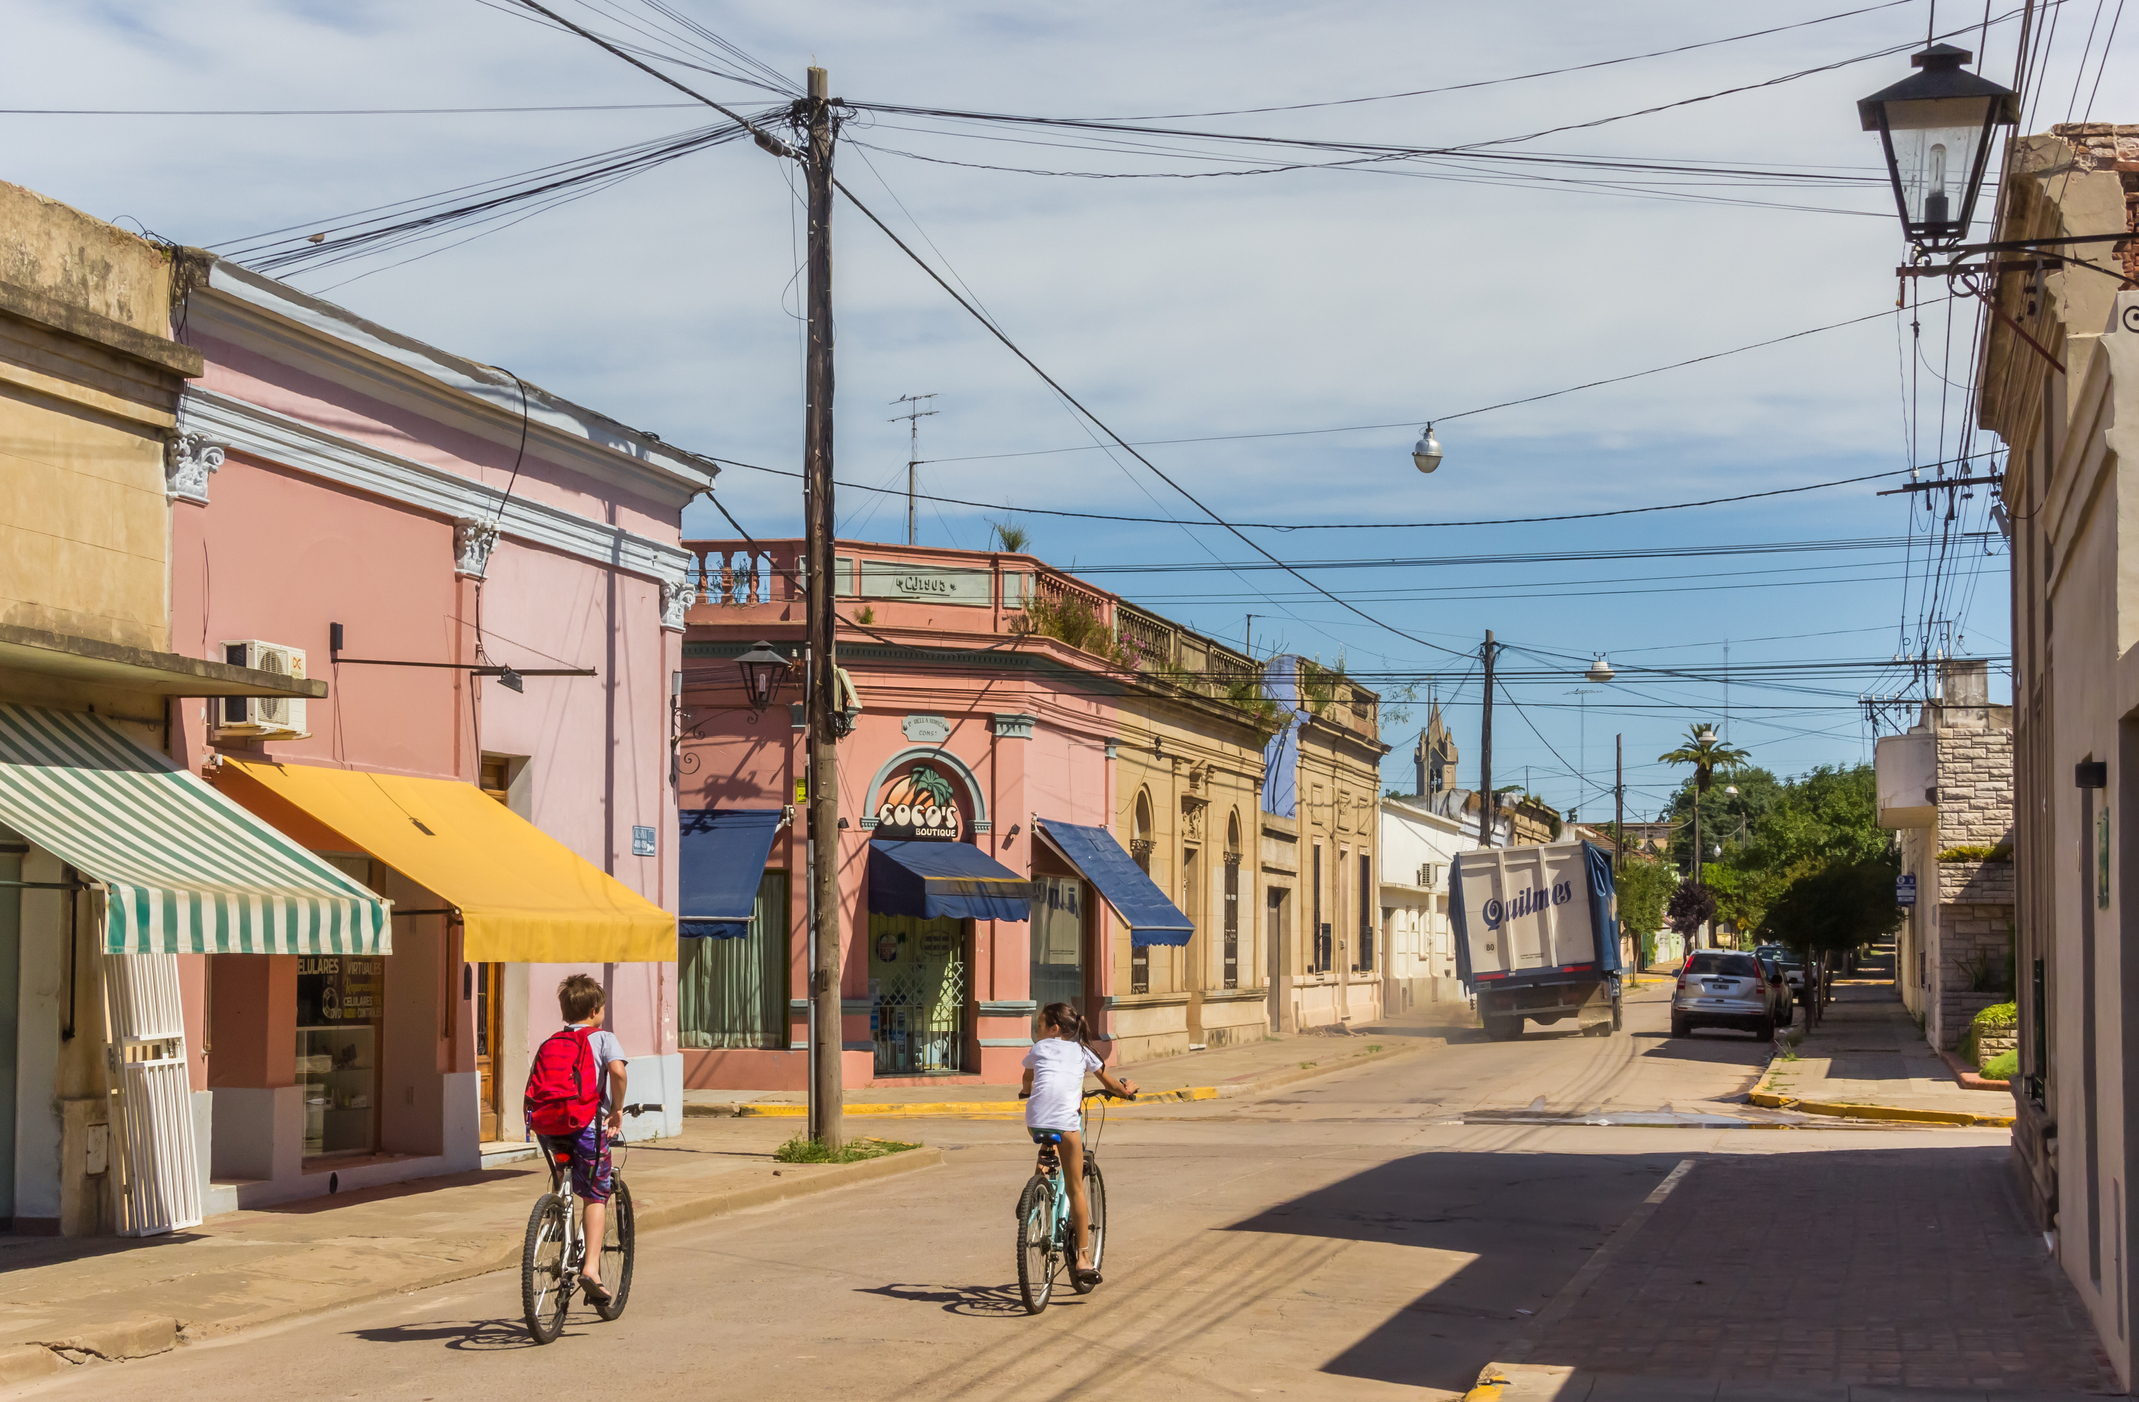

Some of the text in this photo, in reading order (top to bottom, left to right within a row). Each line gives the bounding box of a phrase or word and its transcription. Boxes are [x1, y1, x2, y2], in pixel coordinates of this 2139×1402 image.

[880, 803, 957, 828] COCO'S
[915, 828, 956, 837] BOUTIQUE
[1482, 880, 1572, 932] Quilmes
[298, 958, 339, 975] ELULARES
[347, 961, 382, 975] VIRTUALES
[343, 996, 373, 1007] CELULARES
